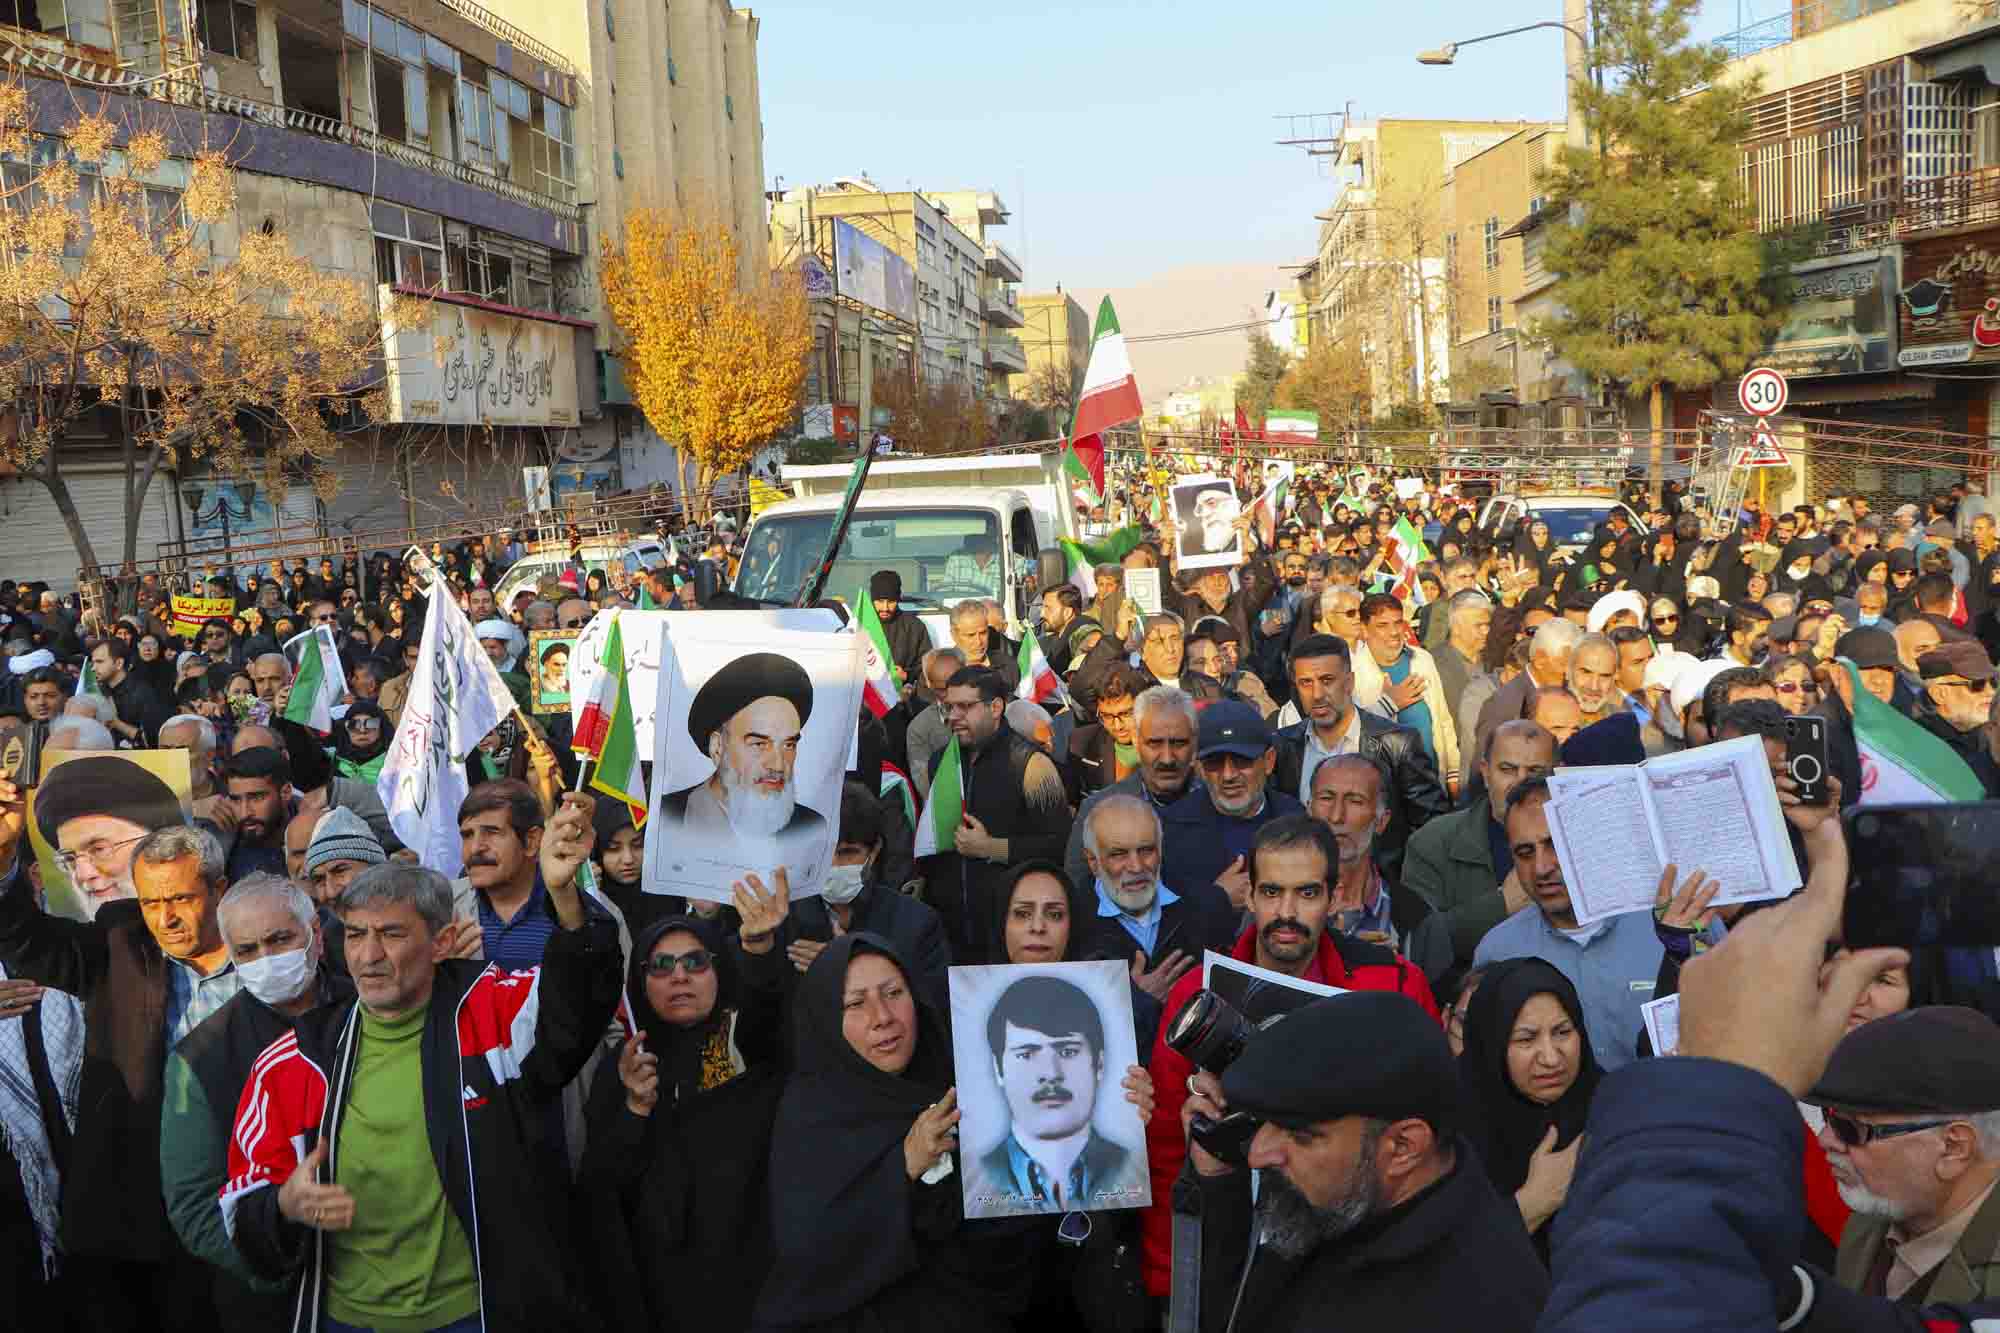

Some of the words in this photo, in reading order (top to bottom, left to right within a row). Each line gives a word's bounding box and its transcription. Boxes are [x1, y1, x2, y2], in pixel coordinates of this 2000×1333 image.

[444, 312, 475, 402] روشنی
[475, 325, 498, 422] چشم
[500, 319, 529, 405] خانگی
[1750, 382, 1777, 404] 30
